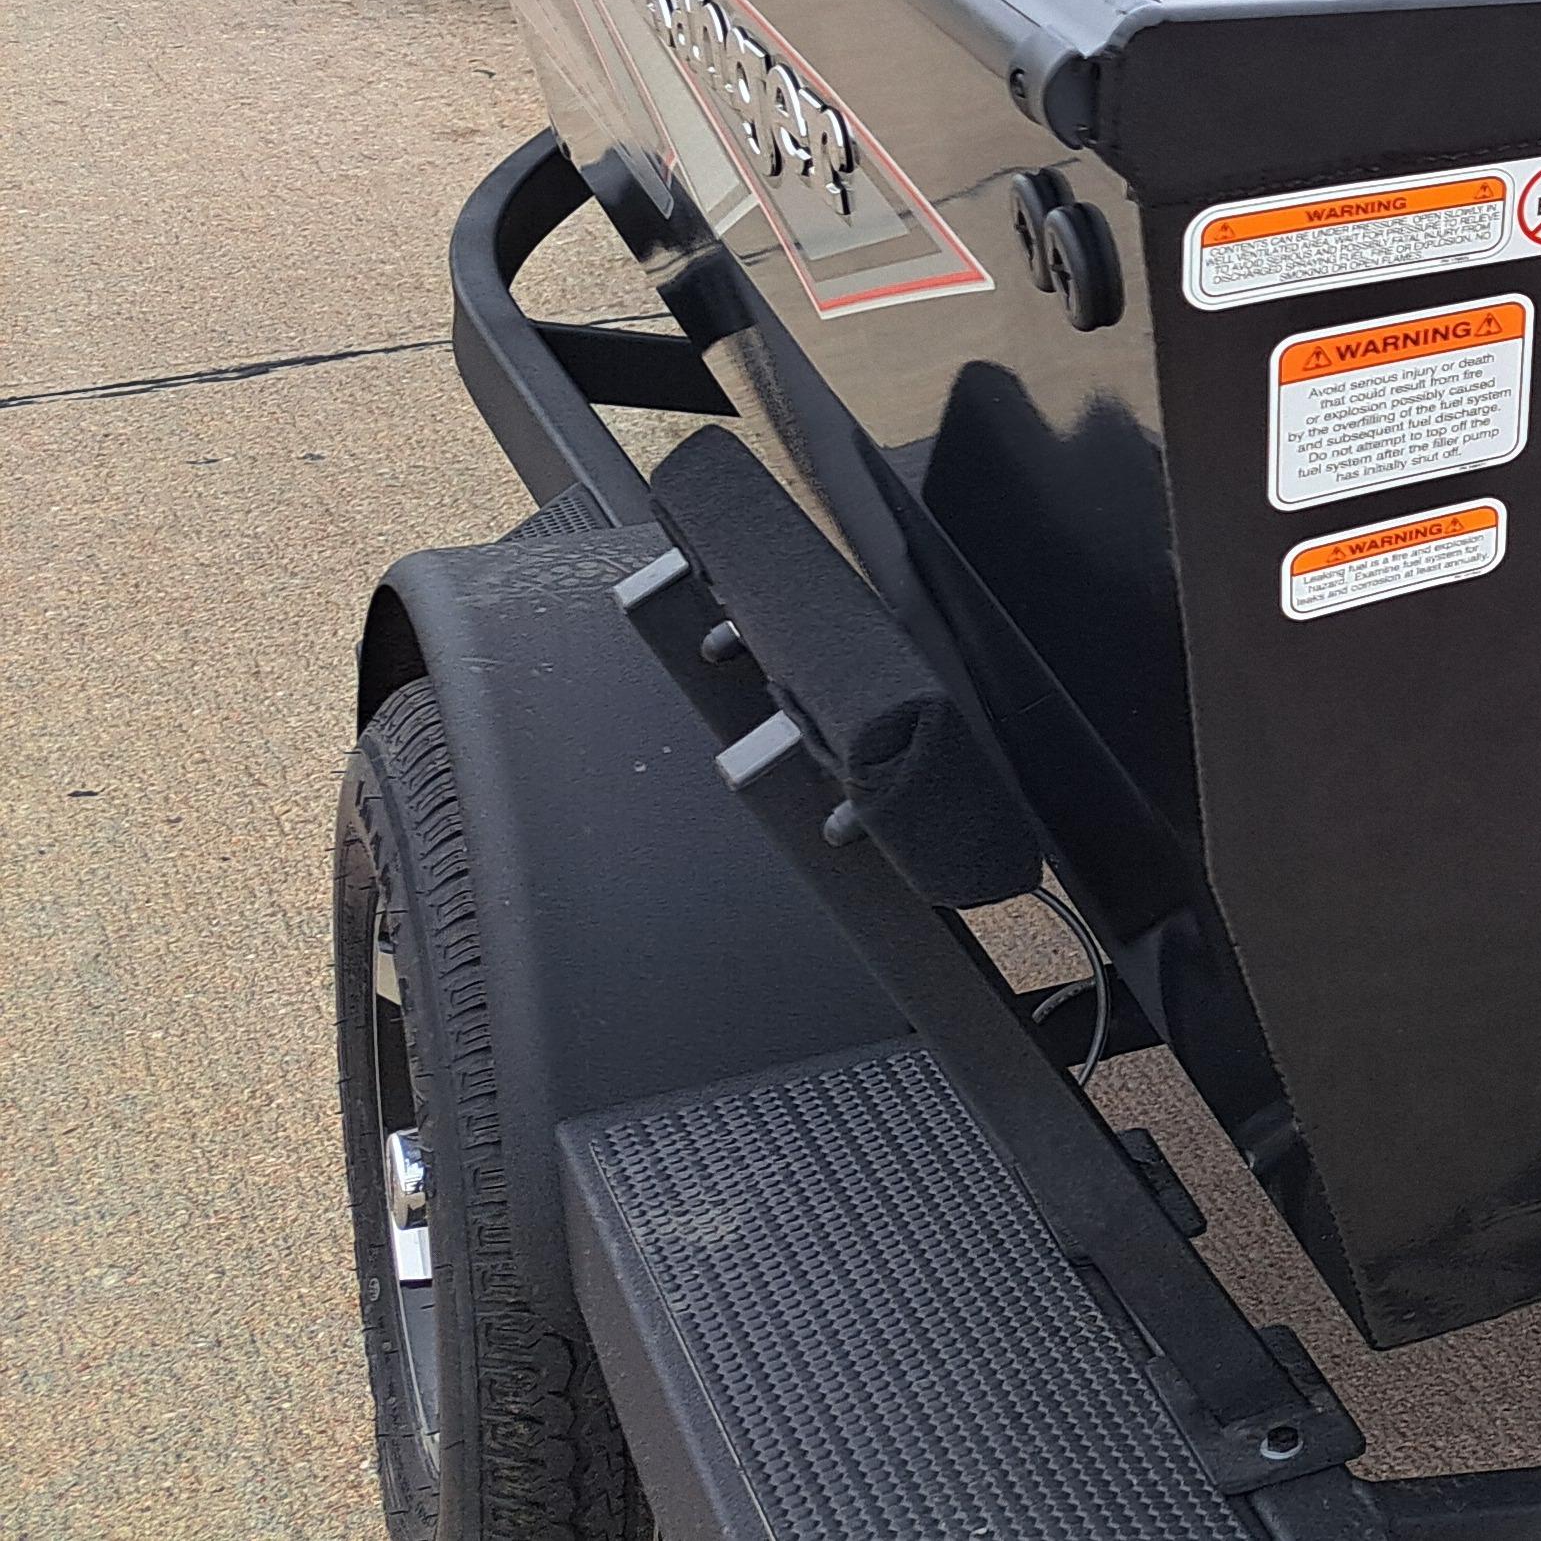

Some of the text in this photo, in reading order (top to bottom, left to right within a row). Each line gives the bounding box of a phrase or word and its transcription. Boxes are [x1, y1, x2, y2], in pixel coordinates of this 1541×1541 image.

[1210, 239, 1268, 257] CONTENTS
[1270, 234, 1293, 247] CAN
[1296, 232, 1310, 241] BE
[1311, 226, 1349, 240] UNDER
[1413, 212, 1441, 224] OPEN
[1443, 206, 1484, 220] SLOWLY
[1486, 203, 1498, 213] IN
[1305, 197, 1408, 223] WARNING
[1205, 255, 1232, 267] WELL
[1236, 244, 1298, 262] VENTILATED
[1334, 232, 1359, 244] WAIT
[1362, 230, 1384, 240] FOR
[1386, 221, 1441, 236] PRESSURE
[1444, 218, 1458, 227] TO
[1460, 211, 1501, 225] RELIEVE
[1213, 265, 1282, 284] DISCHARGED
[1285, 255, 1337, 272] SPRAYING
[1371, 246, 1394, 257] FIRE
[1396, 244, 1412, 254] OR
[1475, 231, 1492, 241] NO
[1215, 223, 1491, 275] TO AVOID SERIOUS AND POSSIBLY FATAL INJURY FROM
[1279, 266, 1329, 281] SMOKING
[1331, 262, 1348, 273] OR
[1350, 258, 1379, 270] OPEN
[1336, 321, 1472, 362] WARNING
[1306, 377, 1495, 425] or explosion possibly caused
[1308, 354, 1495, 399] Avoid serious injury or death
[1320, 366, 1483, 409] that could result from fire
[1287, 387, 1512, 443] by the overfilling of the fuel system
[1297, 402, 1501, 453] and subsequent fuel discharge.
[1308, 416, 1491, 463] Do not attempt to top off the
[1298, 426, 1500, 479] fuel system after the filler pump
[1336, 445, 1462, 483] has initially shut off.
[1303, 534, 1485, 585] Leaking fuel is a fire and explosion
[1349, 523, 1443, 556] WARNING
[1296, 592, 1325, 607] leaks
[1327, 587, 1348, 600] and
[1351, 574, 1401, 593] corrosion
[1404, 568, 1414, 578] at
[1417, 561, 1441, 576] least
[1444, 550, 1490, 570] annually.
[1308, 544, 1480, 594] hazard. Examine fuel system for
